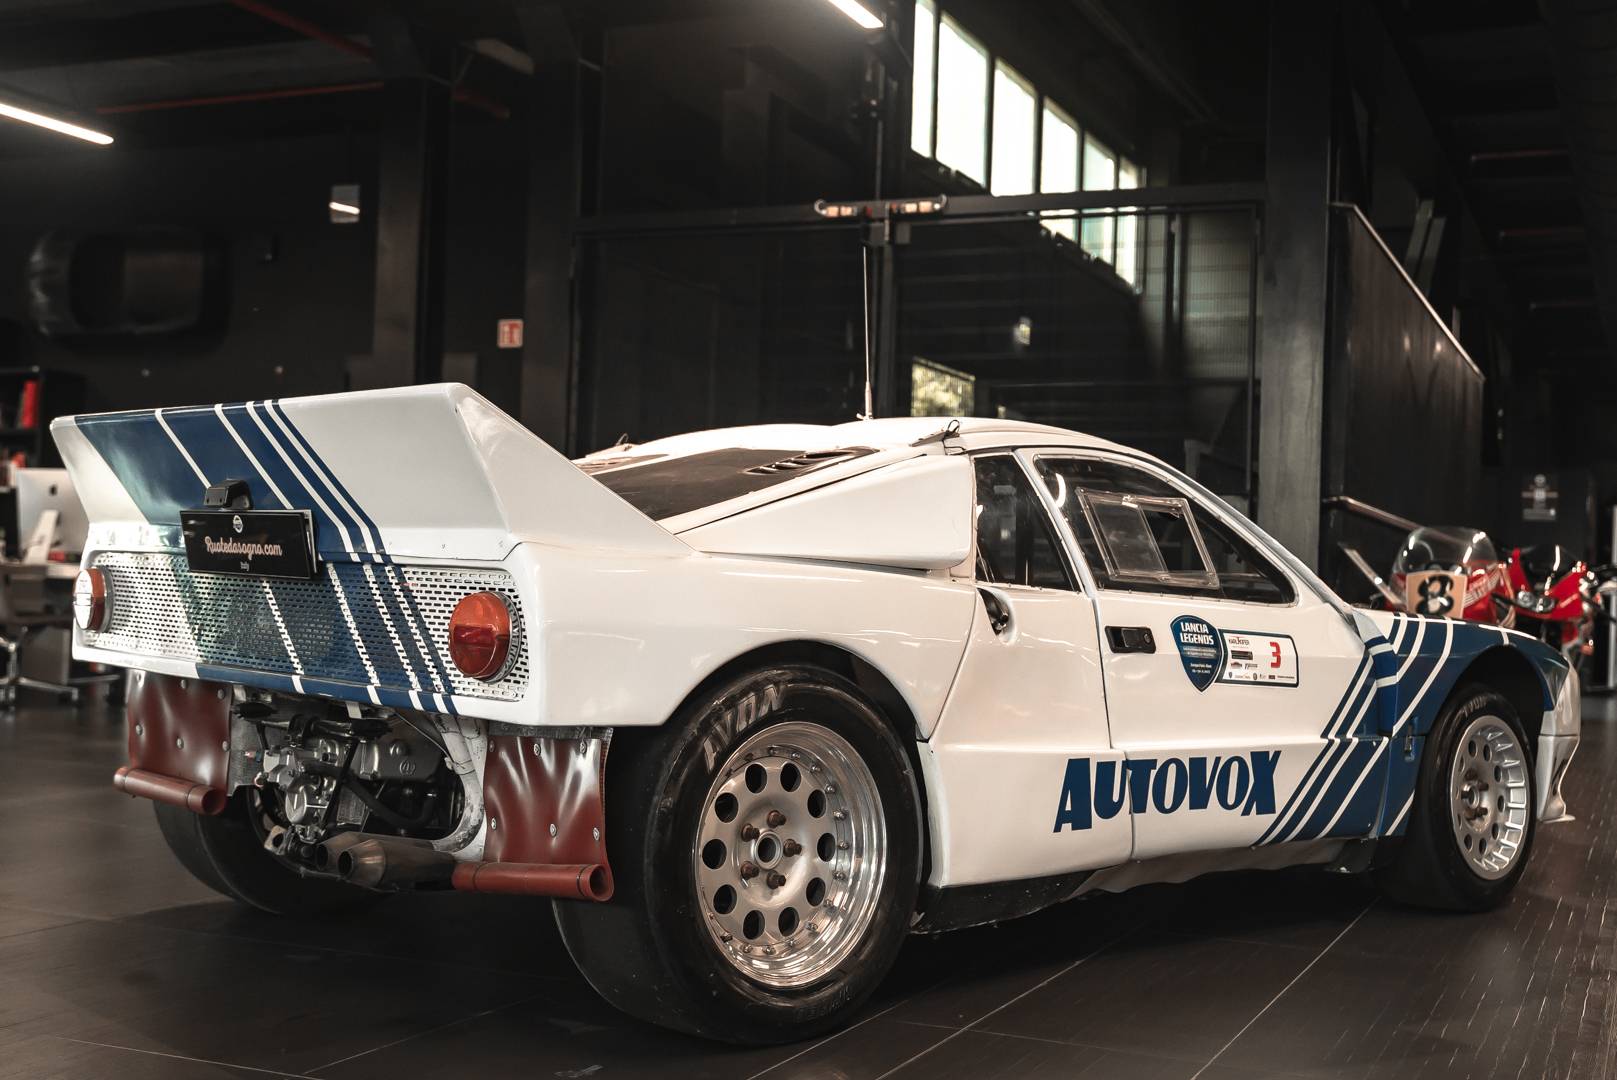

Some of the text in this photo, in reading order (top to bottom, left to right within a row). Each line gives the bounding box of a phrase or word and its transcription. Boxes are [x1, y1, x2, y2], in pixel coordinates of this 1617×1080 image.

[204, 535, 283, 561] Ruotedasogno.com
[1416, 575, 1455, 617] 8
[1179, 632, 1215, 645] LEGENDS
[1180, 621, 1209, 634] LANCIA
[1269, 641, 1281, 669] 3
[1053, 750, 1282, 833] AUTOVOX
